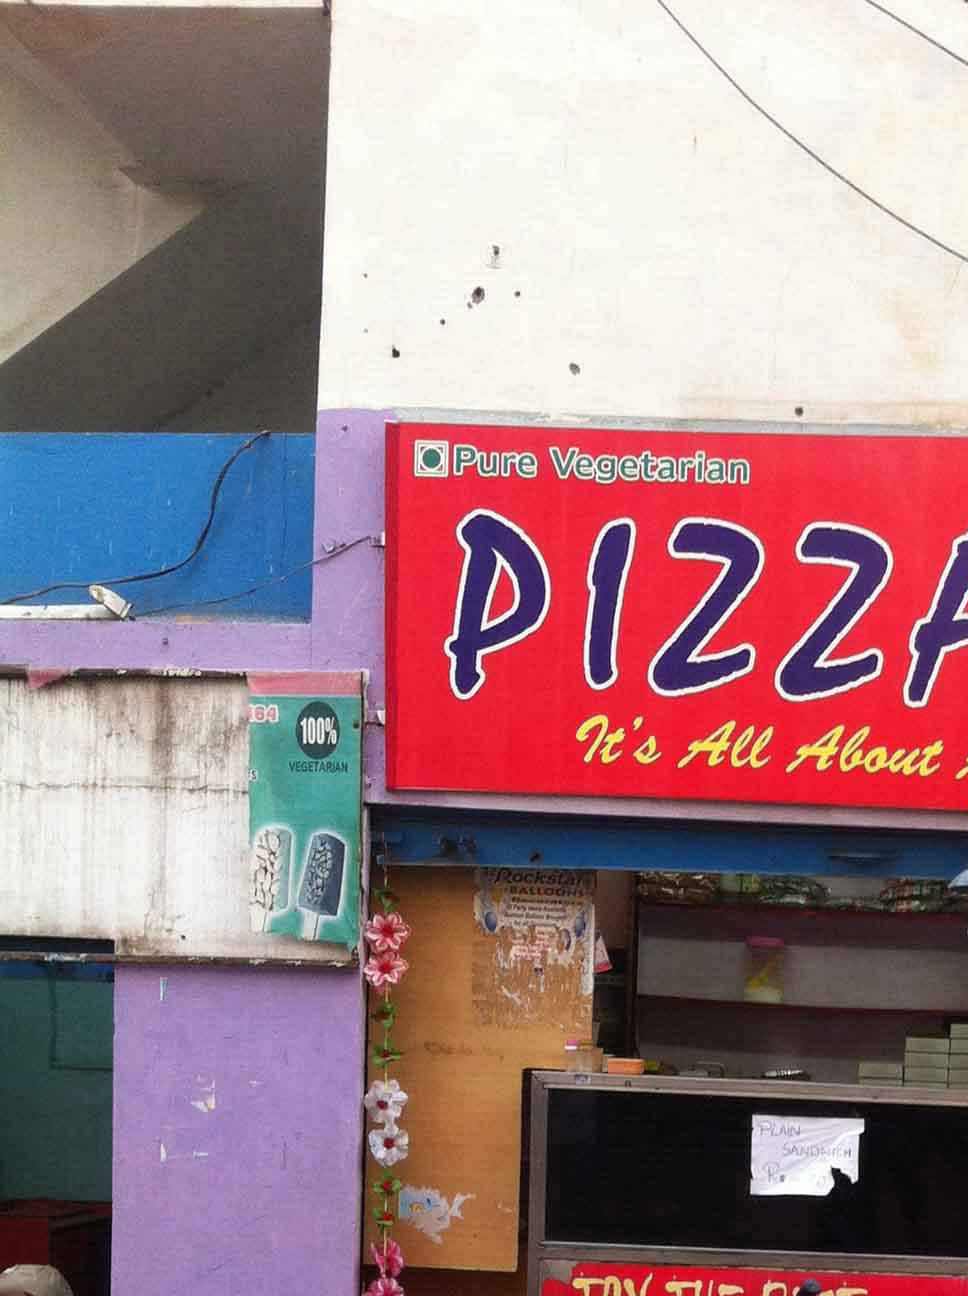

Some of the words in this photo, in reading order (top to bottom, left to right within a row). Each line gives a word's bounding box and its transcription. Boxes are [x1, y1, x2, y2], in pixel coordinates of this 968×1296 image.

[452, 446, 538, 478] Pure
[549, 447, 750, 484] Vegetarian
[300, 716, 337, 745] 100%
[575, 715, 661, 764] It's
[678, 720, 770, 768] All
[786, 725, 943, 777] About
[289, 760, 349, 774] VEGETARIAN
[758, 1120, 801, 1136] PLAIN
